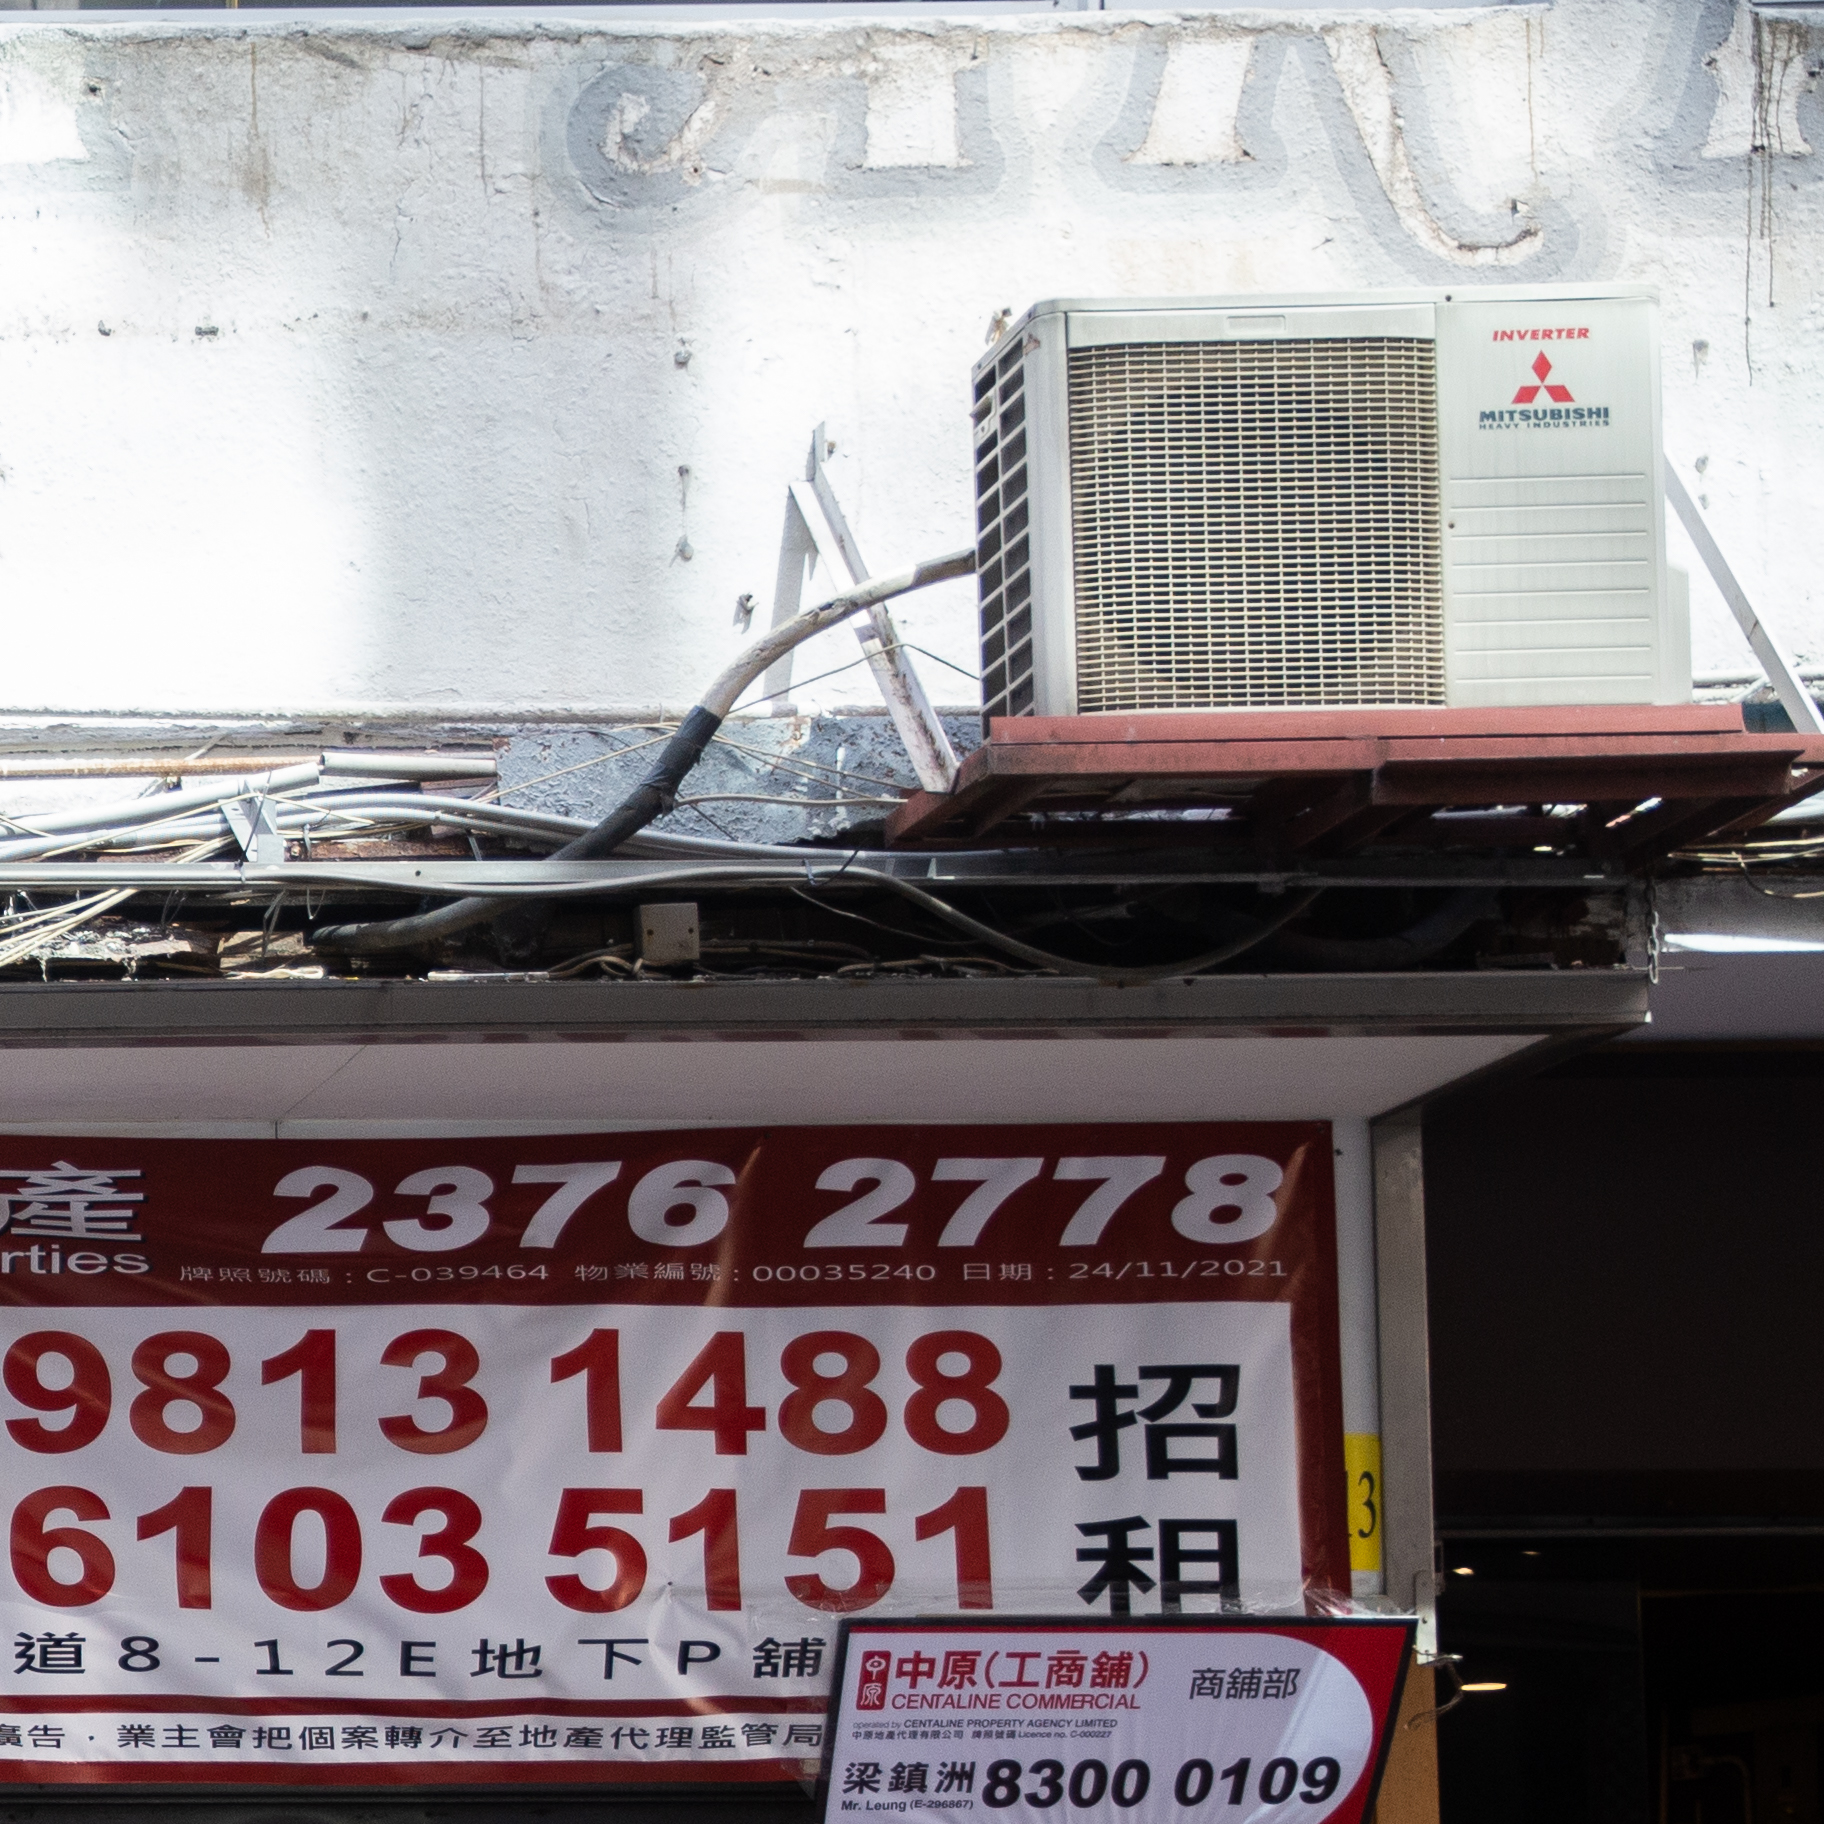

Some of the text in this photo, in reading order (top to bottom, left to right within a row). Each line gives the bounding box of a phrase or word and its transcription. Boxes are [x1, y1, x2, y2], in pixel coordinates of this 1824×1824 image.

[1493, 328, 1590, 341] INVERTER
[1479, 407, 1609, 422] MITSUBISHI
[1479, 419, 1610, 430] HEAVY INDUSTRIES
[261, 1153, 1286, 1254] 2376 2778
[2, 1326, 489, 1458] 9813
[551, 1327, 1011, 1457] 1488
[9, 1484, 490, 1615] 6103
[546, 1484, 994, 1614] 5151
[1189, 1667, 1301, 1700] 商舖部
[891, 1692, 1141, 1710] CENTALINE COMMERCIAL
[852, 1721, 889, 1731] operated
[904, 1719, 964, 1728] CENTALINE
[967, 1719, 1024, 1728] PROPERTY
[1027, 1719, 1073, 1728] AGENCY
[1075, 1719, 1118, 1728] LIMITED
[843, 1755, 1341, 1809] 梁鎮洲 8300 0109
[841, 1801, 862, 1812] Mr.
[866, 1800, 906, 1813] Leung
